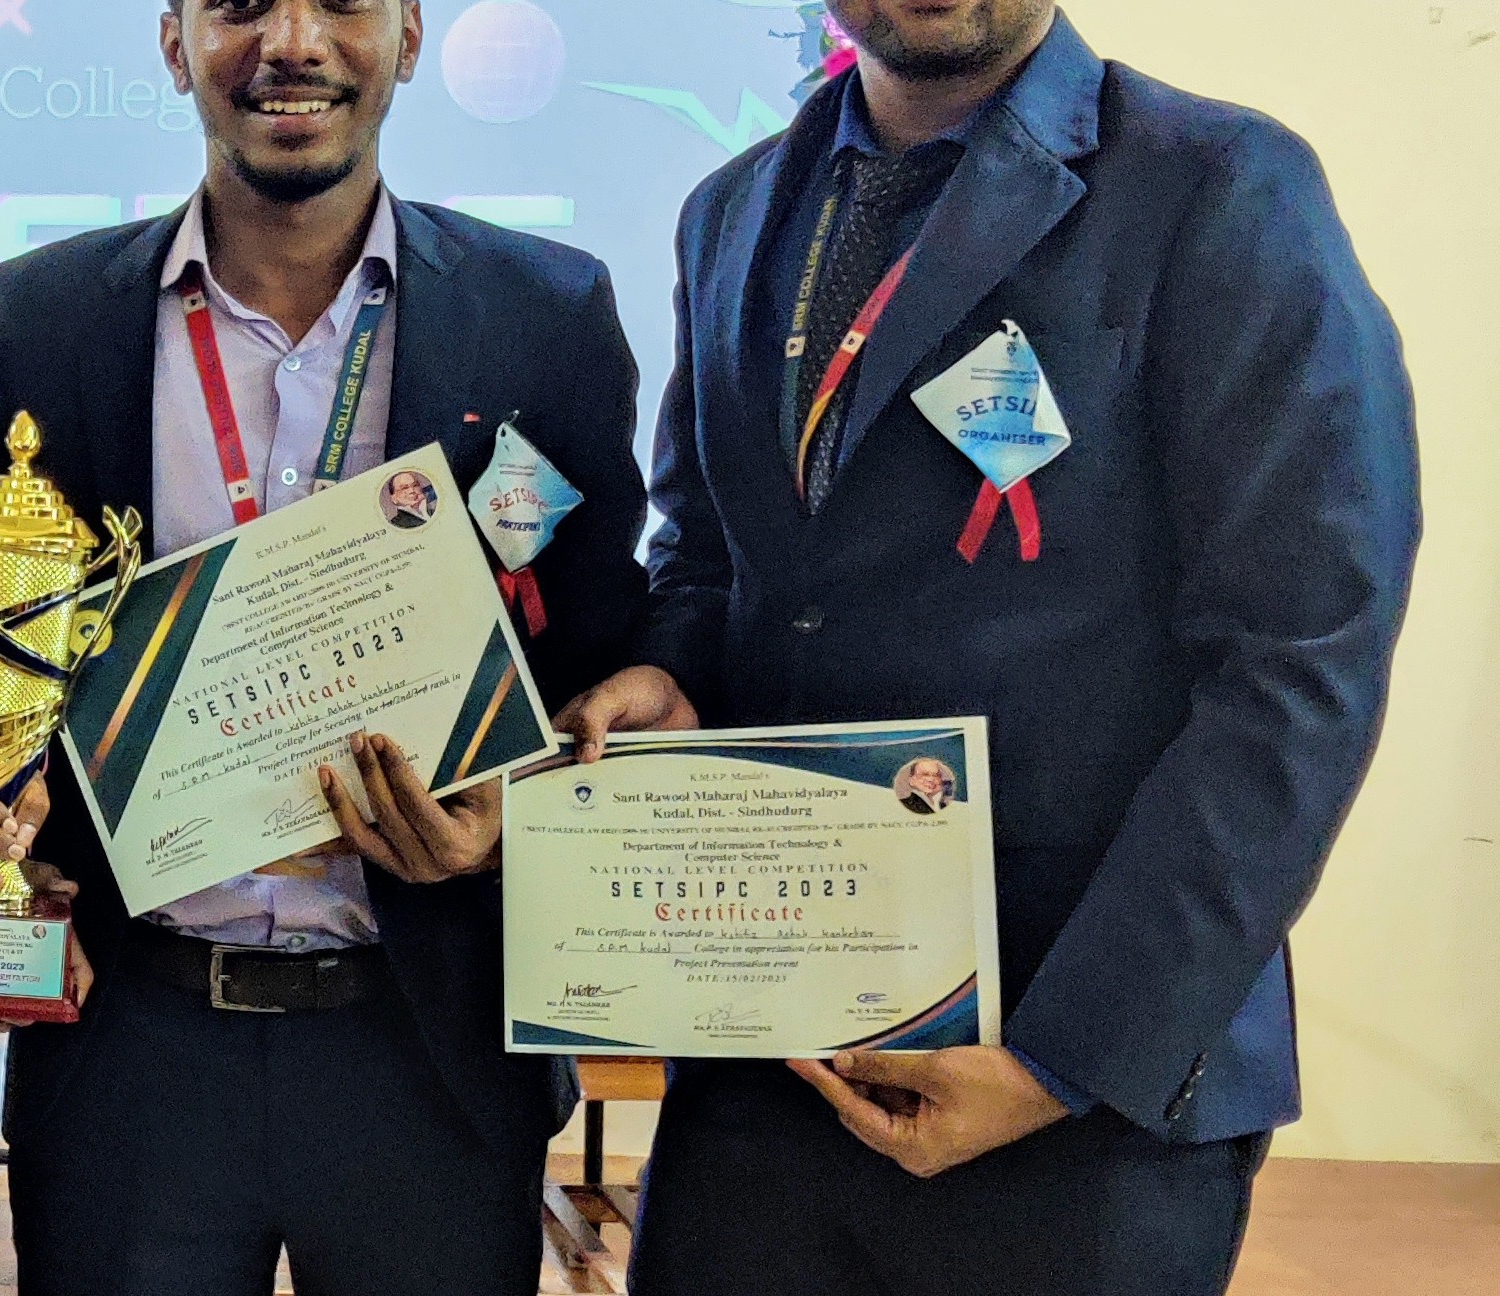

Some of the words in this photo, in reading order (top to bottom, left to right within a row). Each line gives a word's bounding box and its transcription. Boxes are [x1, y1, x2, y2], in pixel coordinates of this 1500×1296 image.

[350, 329, 372, 375] KUDAL
[333, 376, 360, 441] COLLEGE
[324, 443, 343, 474] SRM
[212, 590, 234, 605] Sant
[272, 556, 315, 580] Maharaj
[315, 528, 387, 562] Mahavidyalaya
[201, 637, 258, 668] Department
[259, 632, 270, 644] of
[271, 611, 328, 641] Information
[385, 582, 394, 592] &
[260, 629, 308, 656] Computer
[309, 616, 344, 637] Science
[173, 671, 249, 707] NATIONAL
[256, 649, 304, 675] LEVEL
[311, 603, 416, 652] COMPETITION
[188, 663, 312, 725] SETSIPC
[333, 626, 404, 667] 2023
[430, 677, 450, 692] rank
[452, 672, 461, 683] in
[220, 674, 357, 736] Certificate
[275, 735, 307, 752] College
[324, 713, 362, 732] Securing
[160, 766, 179, 781] This
[181, 750, 224, 774] Certificate
[236, 733, 273, 753] Awarded
[274, 727, 283, 736] to
[258, 757, 288, 775] Project
[291, 735, 343, 761] Presentation
[152, 789, 162, 800] of
[613, 792, 640, 803] Sant
[644, 791, 690, 802] Rawool
[694, 790, 748, 803] Maharaj
[752, 788, 848, 800] Mahavidyalaya
[698, 807, 725, 818] Dist.
[737, 806, 813, 817] Sindhudurg
[623, 841, 685, 853] Department
[688, 841, 699, 850] of
[702, 840, 765, 850] Information
[768, 839, 829, 850] Technology
[833, 839, 842, 848] &
[685, 853, 737, 864] Computer
[741, 853, 780, 862] Science
[589, 865, 675, 875] NATIONAL
[685, 865, 737, 875] LEVEL
[747, 863, 869, 875] COMPETITION
[611, 881, 748, 898] SETSIPC
[777, 879, 857, 898] 2023
[655, 902, 804, 924] Certificate
[554, 941, 566, 951] of
[575, 927, 595, 937] This
[598, 927, 647, 939] Certificate
[661, 929, 702, 938] Awarded
[674, 959, 708, 968] Project
